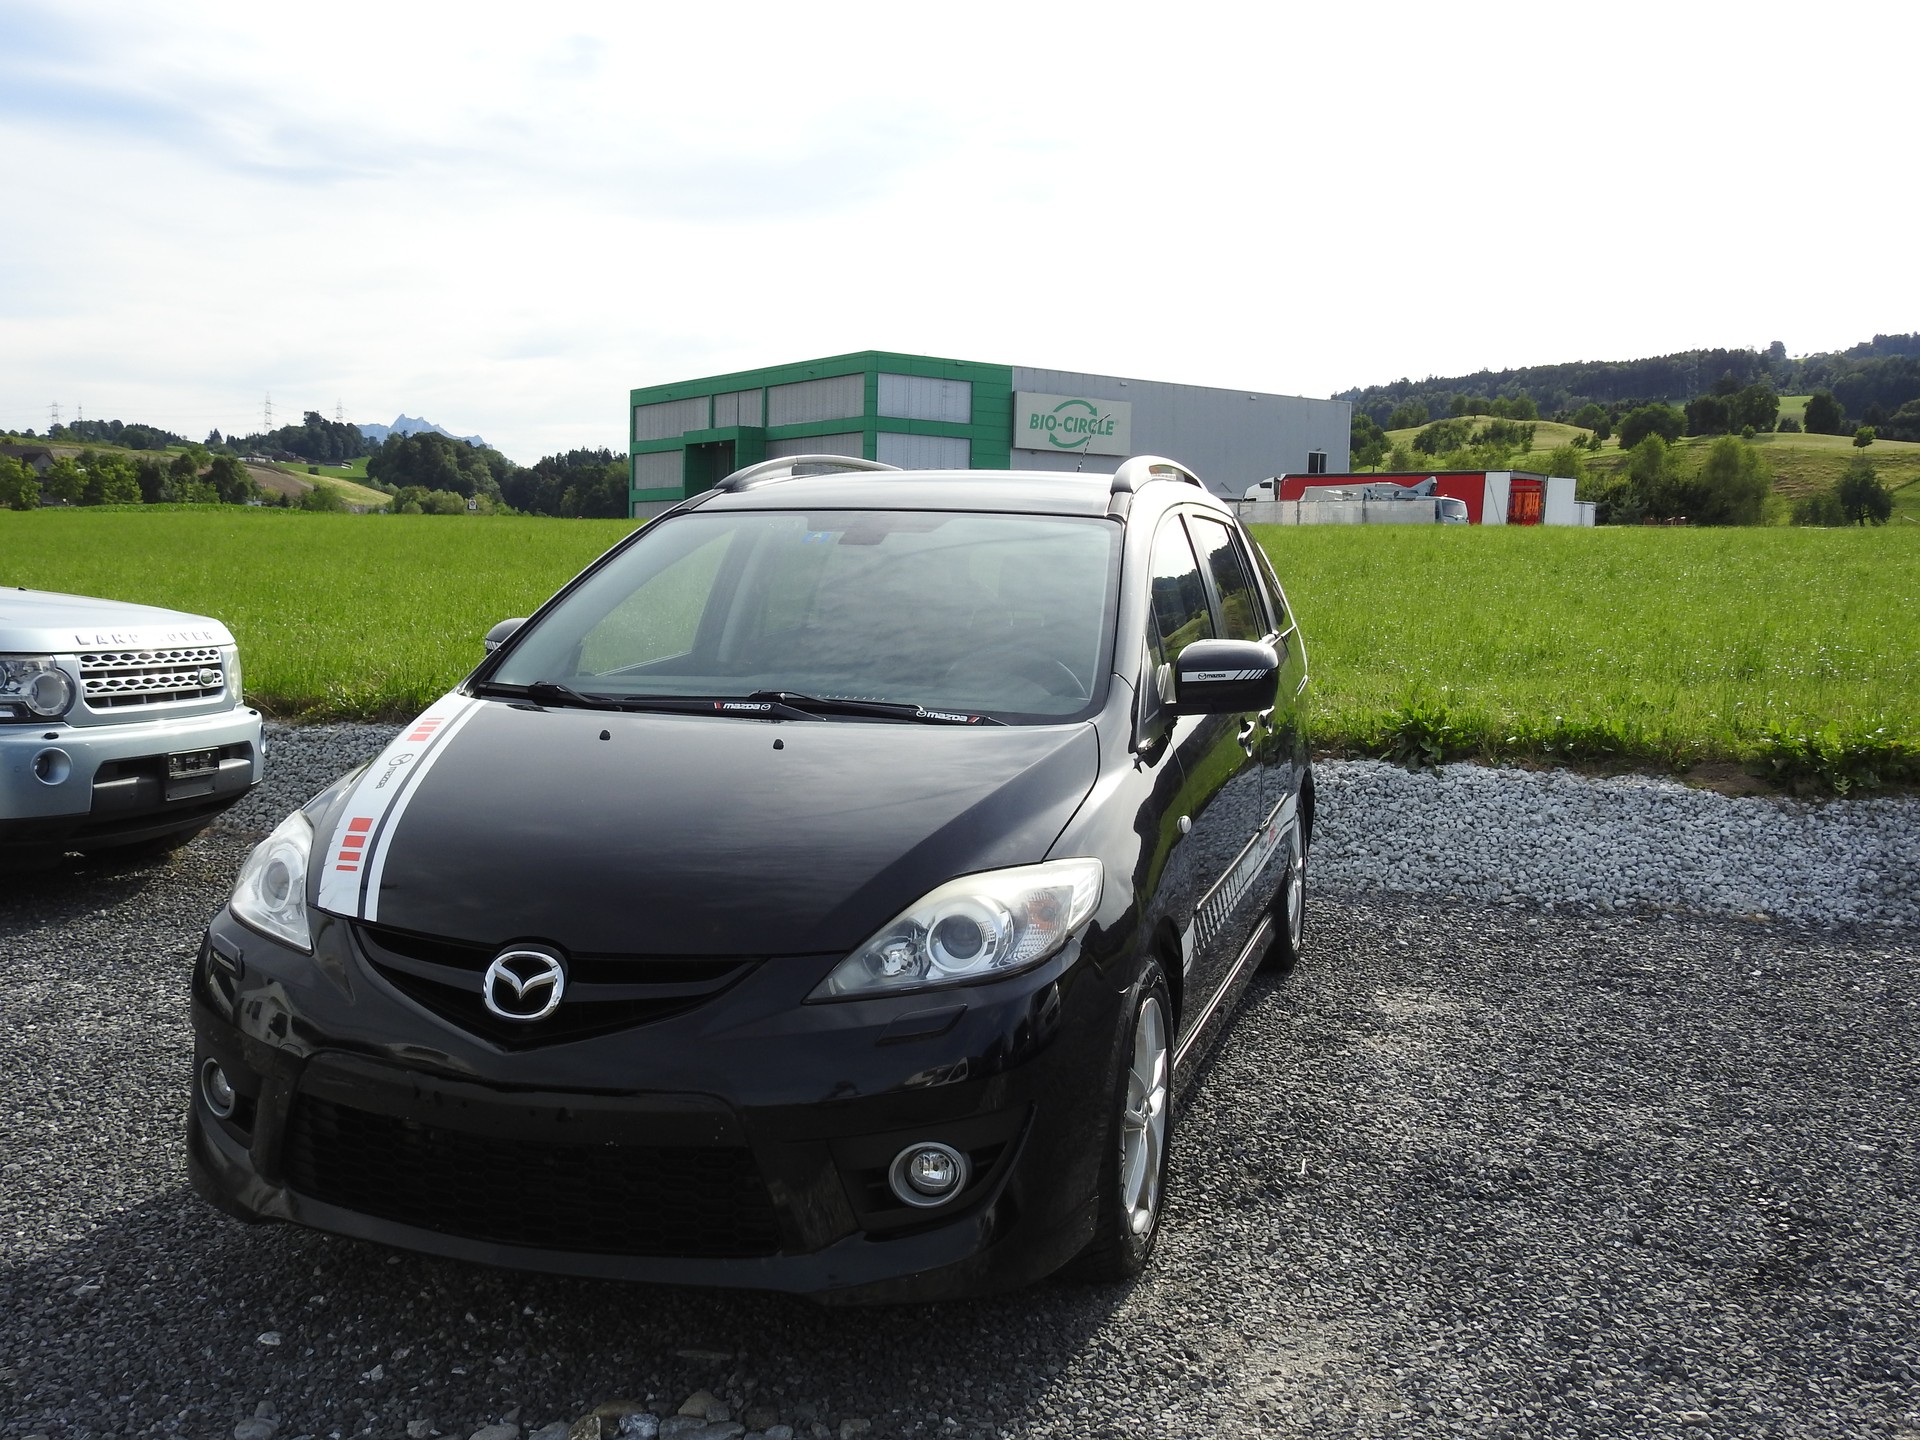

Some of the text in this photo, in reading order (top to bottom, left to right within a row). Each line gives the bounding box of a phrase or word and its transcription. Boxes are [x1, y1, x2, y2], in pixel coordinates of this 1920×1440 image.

[1029, 413, 1115, 436] BIO-CIRCLE
[158, 631, 213, 642] OVER
[926, 711, 968, 722] mazda
[375, 766, 397, 789] mazda
